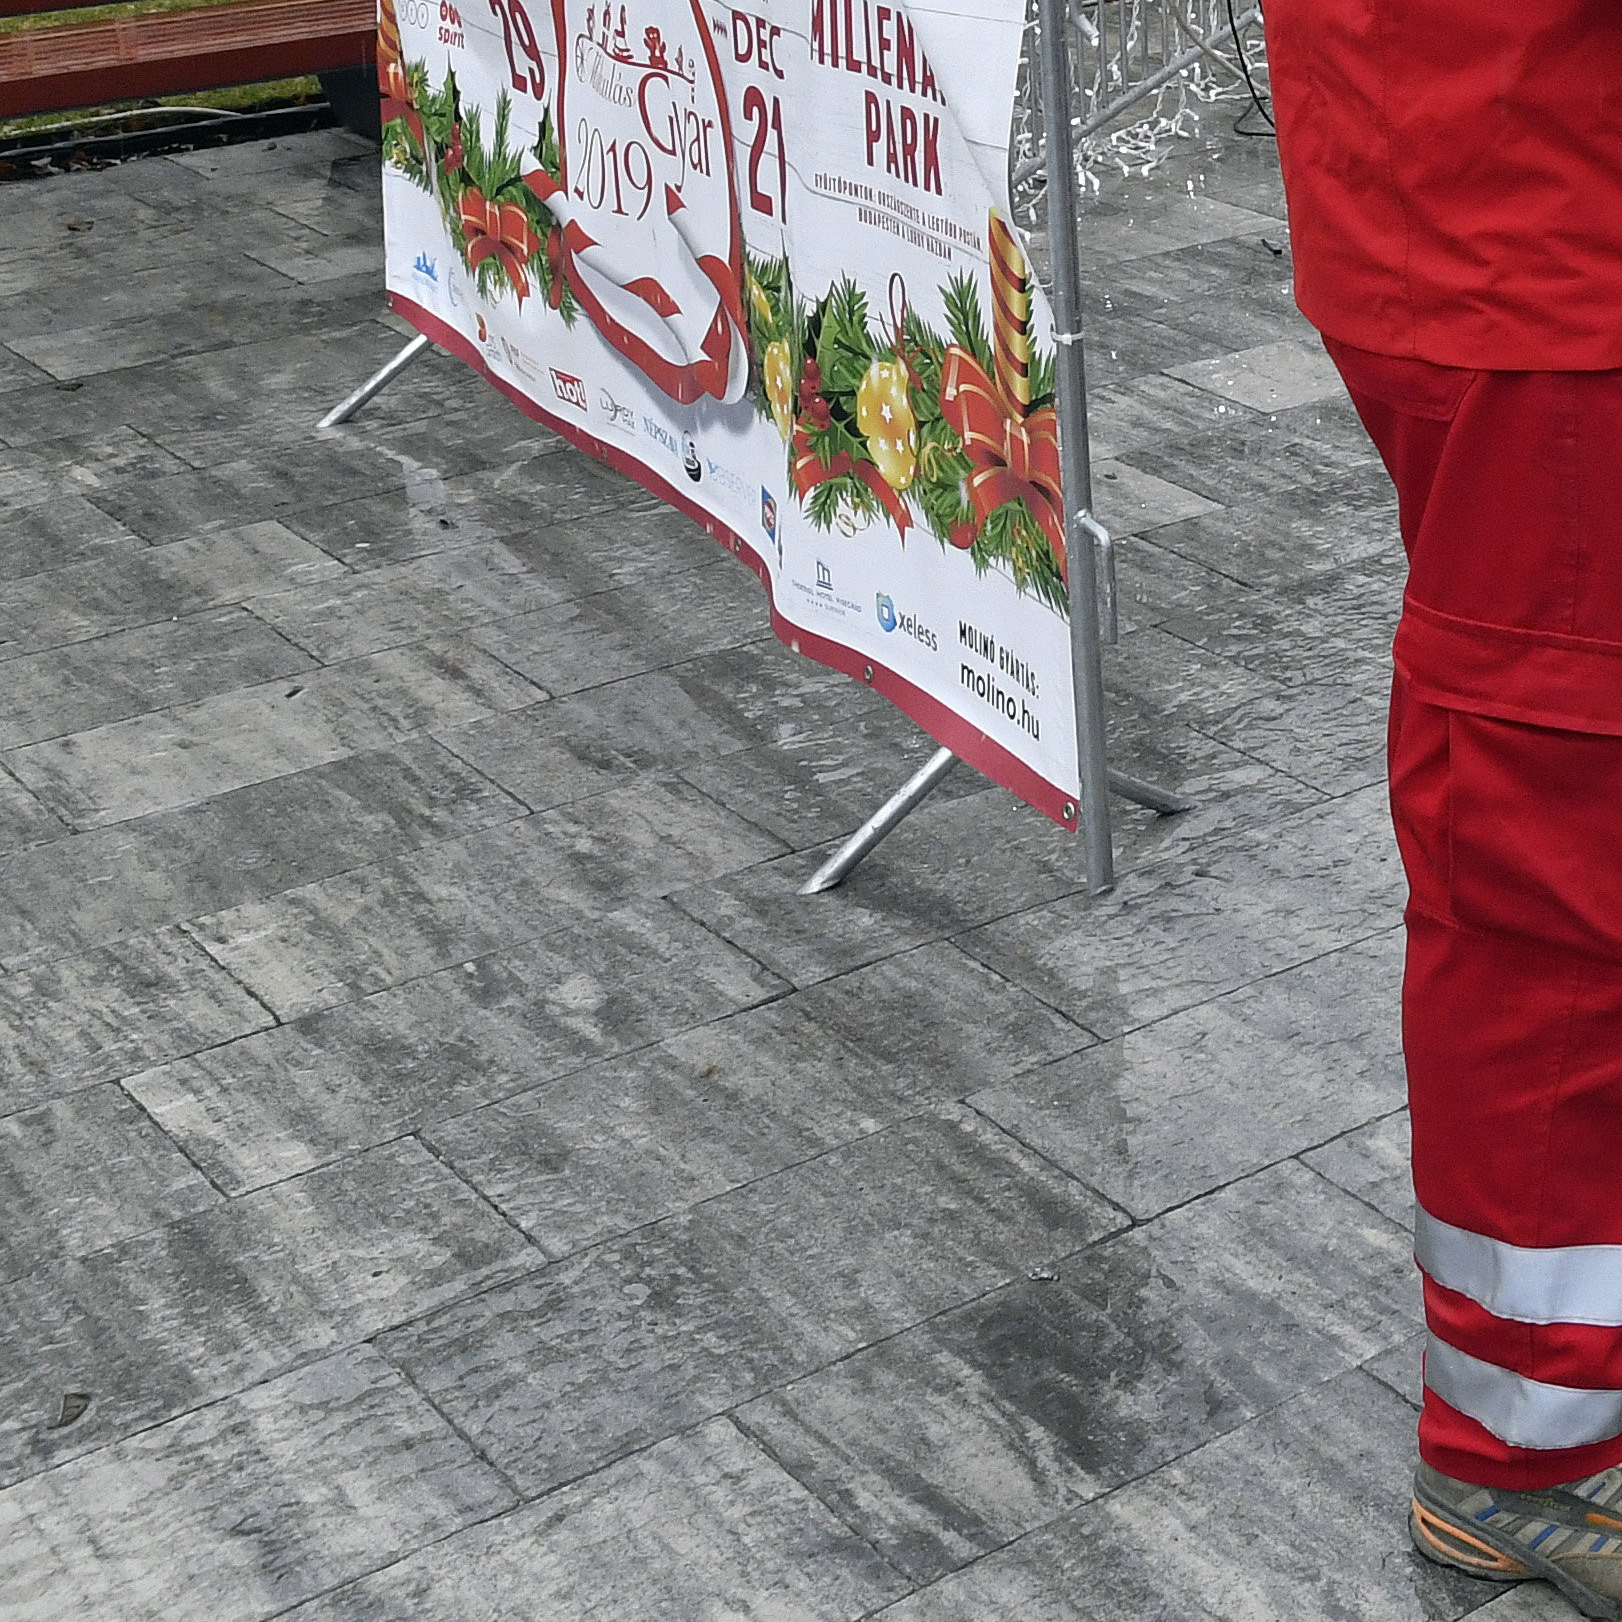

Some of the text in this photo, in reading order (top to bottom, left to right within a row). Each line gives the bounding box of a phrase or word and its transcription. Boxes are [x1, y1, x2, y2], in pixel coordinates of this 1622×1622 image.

[438, 26, 465, 50] spirit
[731, 9, 785, 80] DEC
[573, 117, 653, 222] 2019
[743, 85, 788, 226] 21
[864, 88, 943, 197] PARK
[898, 611, 938, 653] xeless
[958, 620, 1041, 700] MOLINÓ GYÁRTÁS:
[960, 662, 1041, 742] molino.hu
